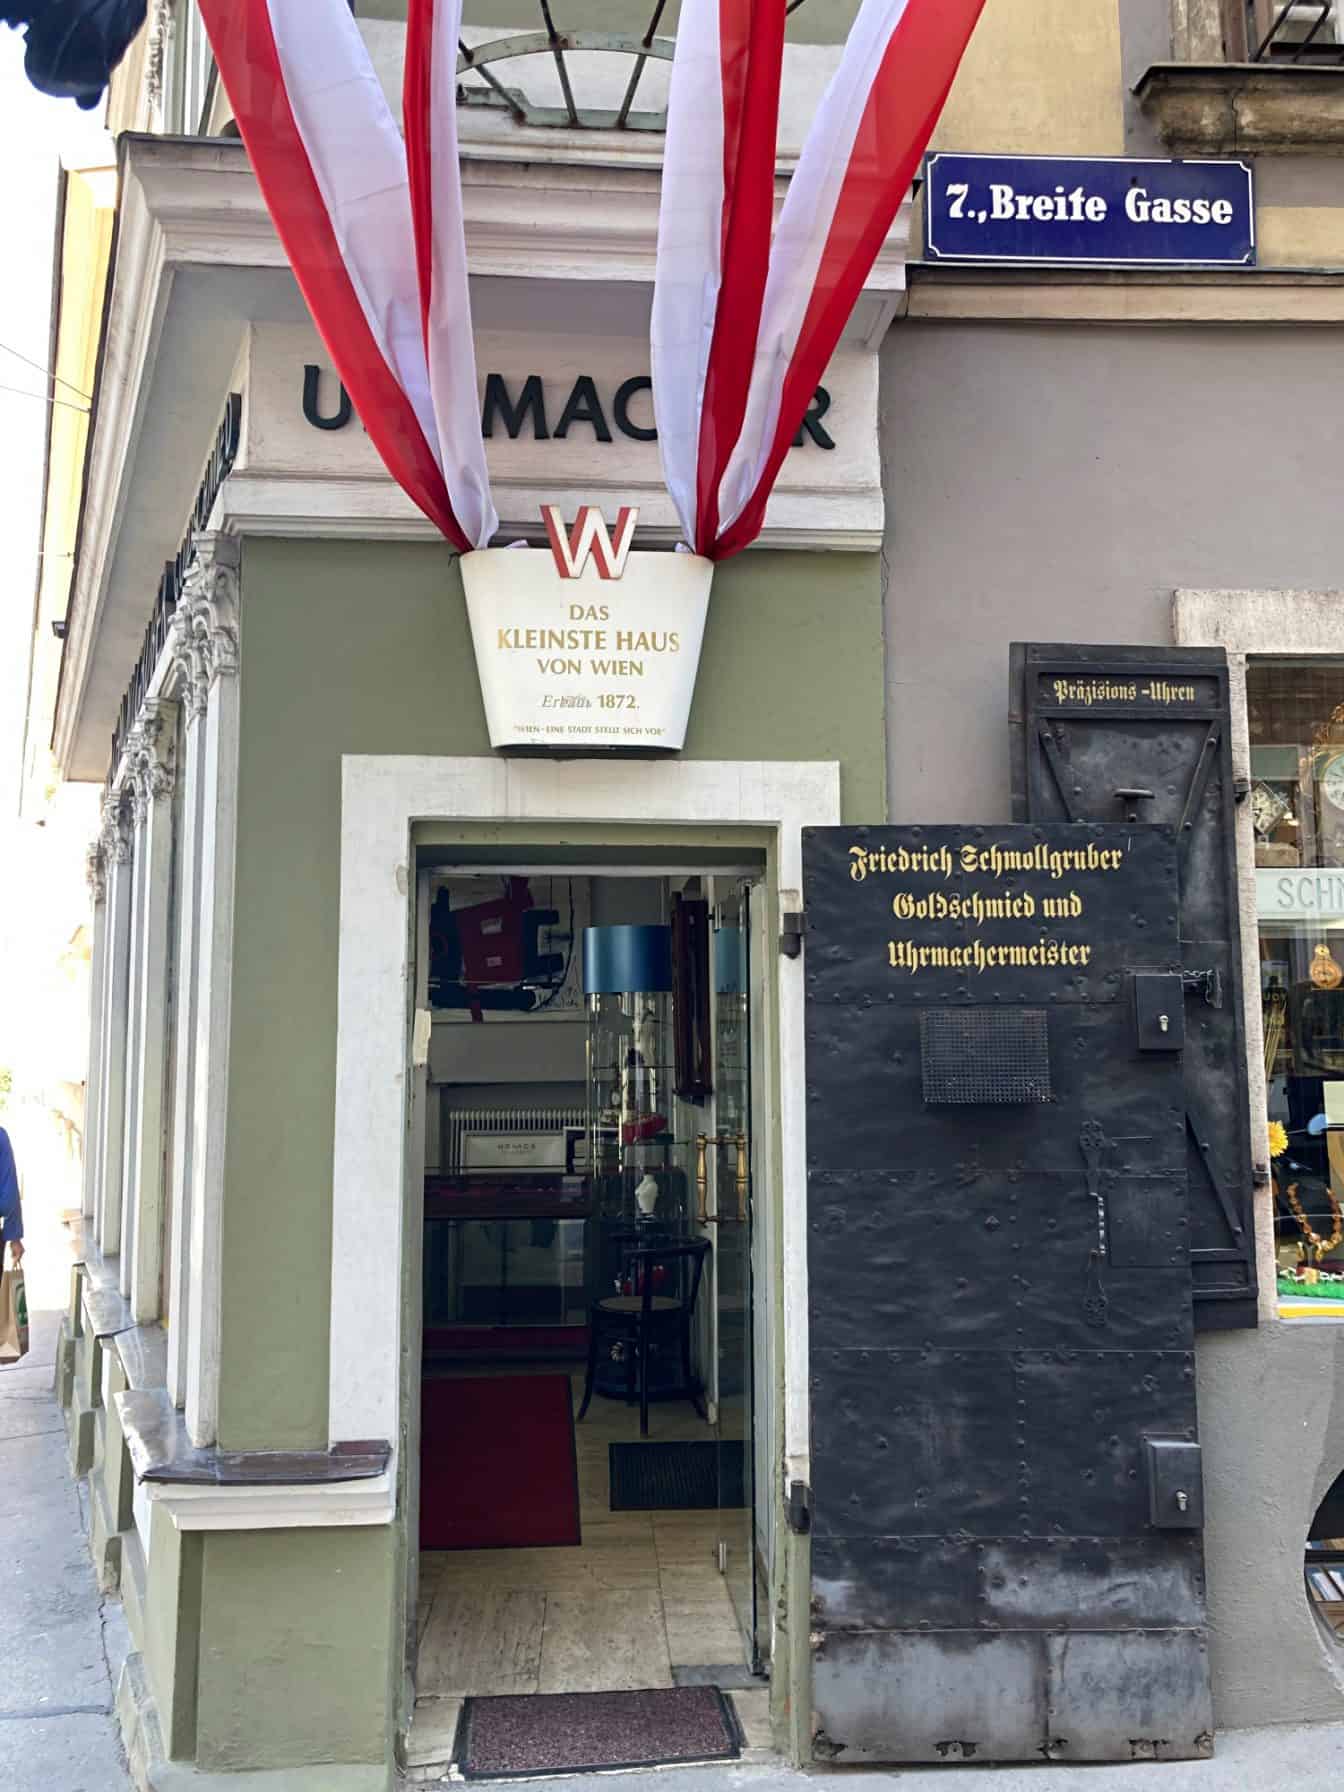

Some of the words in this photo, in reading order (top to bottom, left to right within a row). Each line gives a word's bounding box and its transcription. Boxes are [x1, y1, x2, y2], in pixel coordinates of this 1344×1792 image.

[1124, 188, 1233, 224] Gasse
[540, 504, 640, 580] W
[569, 604, 609, 621] DAS
[498, 628, 606, 650] KLEINSTE
[616, 631, 680, 652] HAUS
[537, 658, 582, 675] VON
[590, 659, 643, 676] WIEN
[1053, 679, 1137, 706] Präzisions
[849, 844, 953, 882] Friedrich
[959, 842, 1123, 879] Schmollgruber
[892, 890, 1036, 927] Goldschmied
[1042, 890, 1083, 918] und
[1277, 876, 1344, 909] SCH
[887, 938, 1092, 975] Uhrmachermeister
